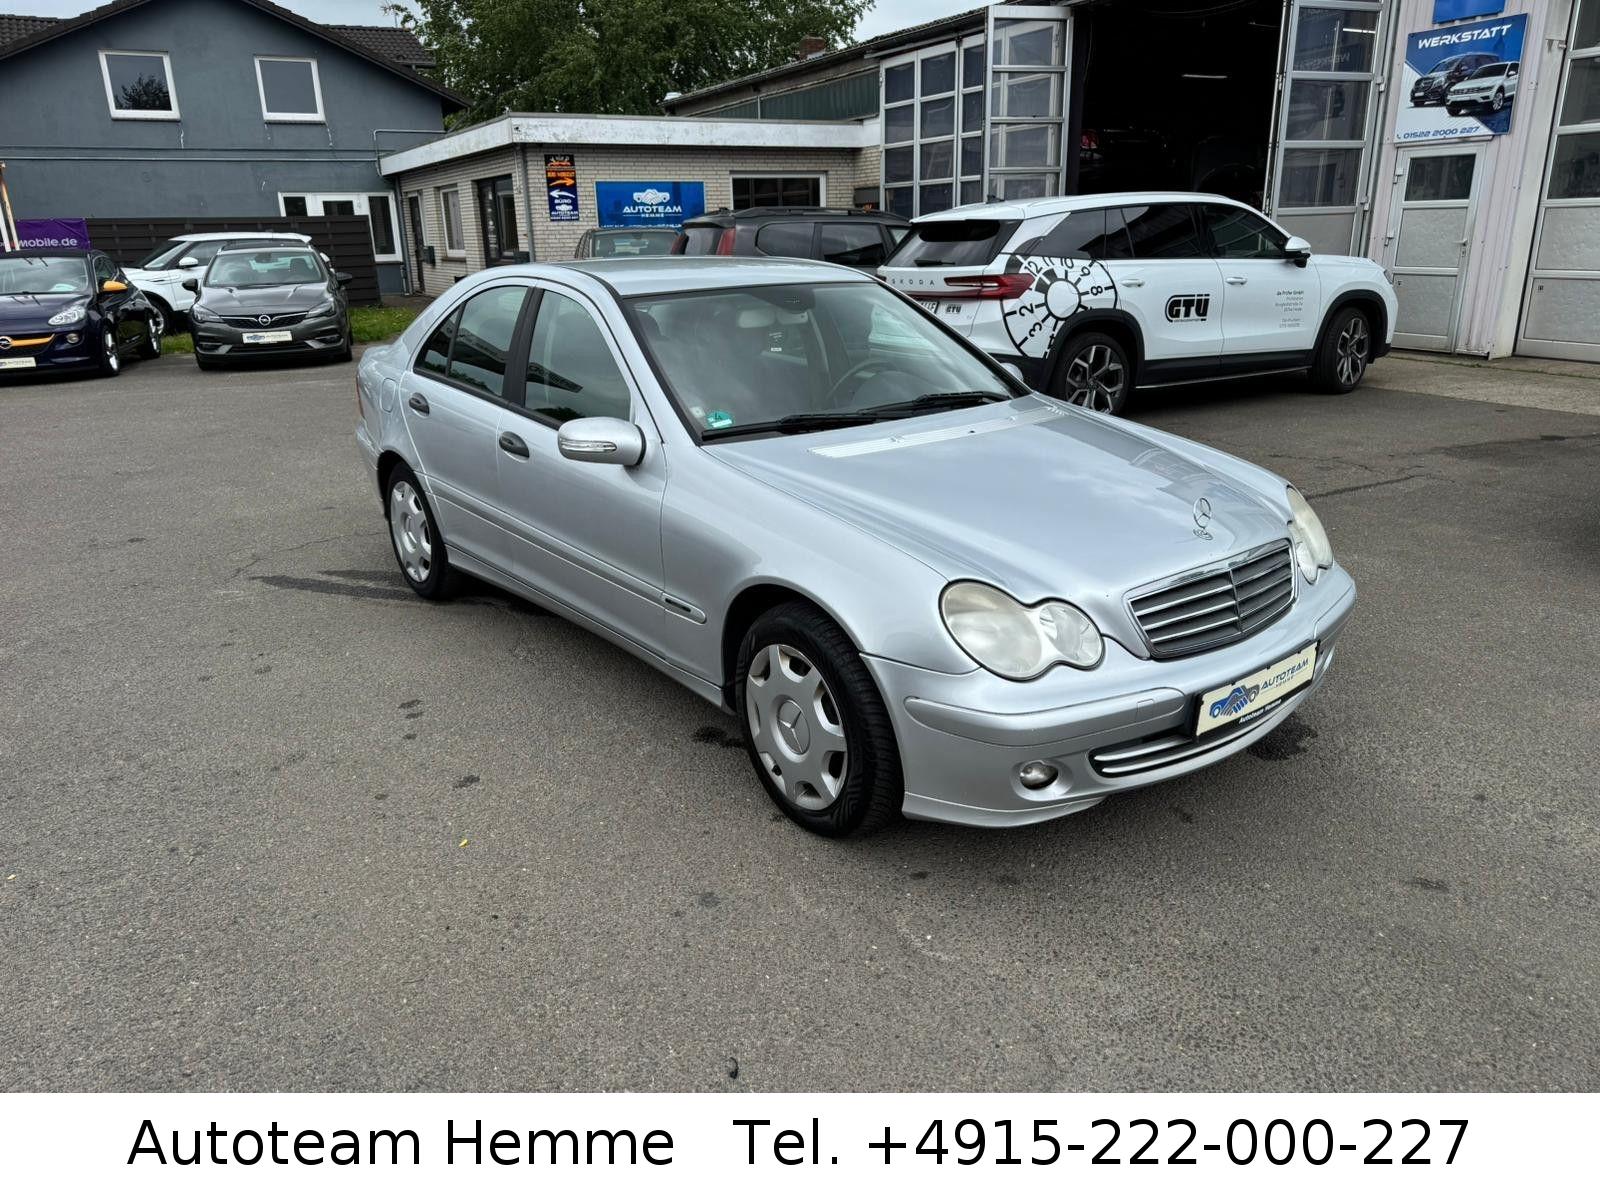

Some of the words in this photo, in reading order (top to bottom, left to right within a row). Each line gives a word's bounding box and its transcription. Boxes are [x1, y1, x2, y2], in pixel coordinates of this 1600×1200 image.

[1418, 24, 1512, 49] WERKSTATT
[1403, 130, 1431, 139] 01522
[1432, 128, 1458, 136] 2000
[1459, 126, 1480, 134] 227
[623, 205, 683, 213] AUTOTEAM
[19, 237, 78, 248] mobile.de
[1024, 260, 1043, 277] 12
[1080, 265, 1091, 277] 9
[1090, 285, 1104, 296] 8
[1018, 303, 1034, 317] 2
[1165, 294, 1211, 321] GTÜ
[1028, 322, 1043, 338] 3
[1261, 658, 1309, 689] AUTOTEAM
